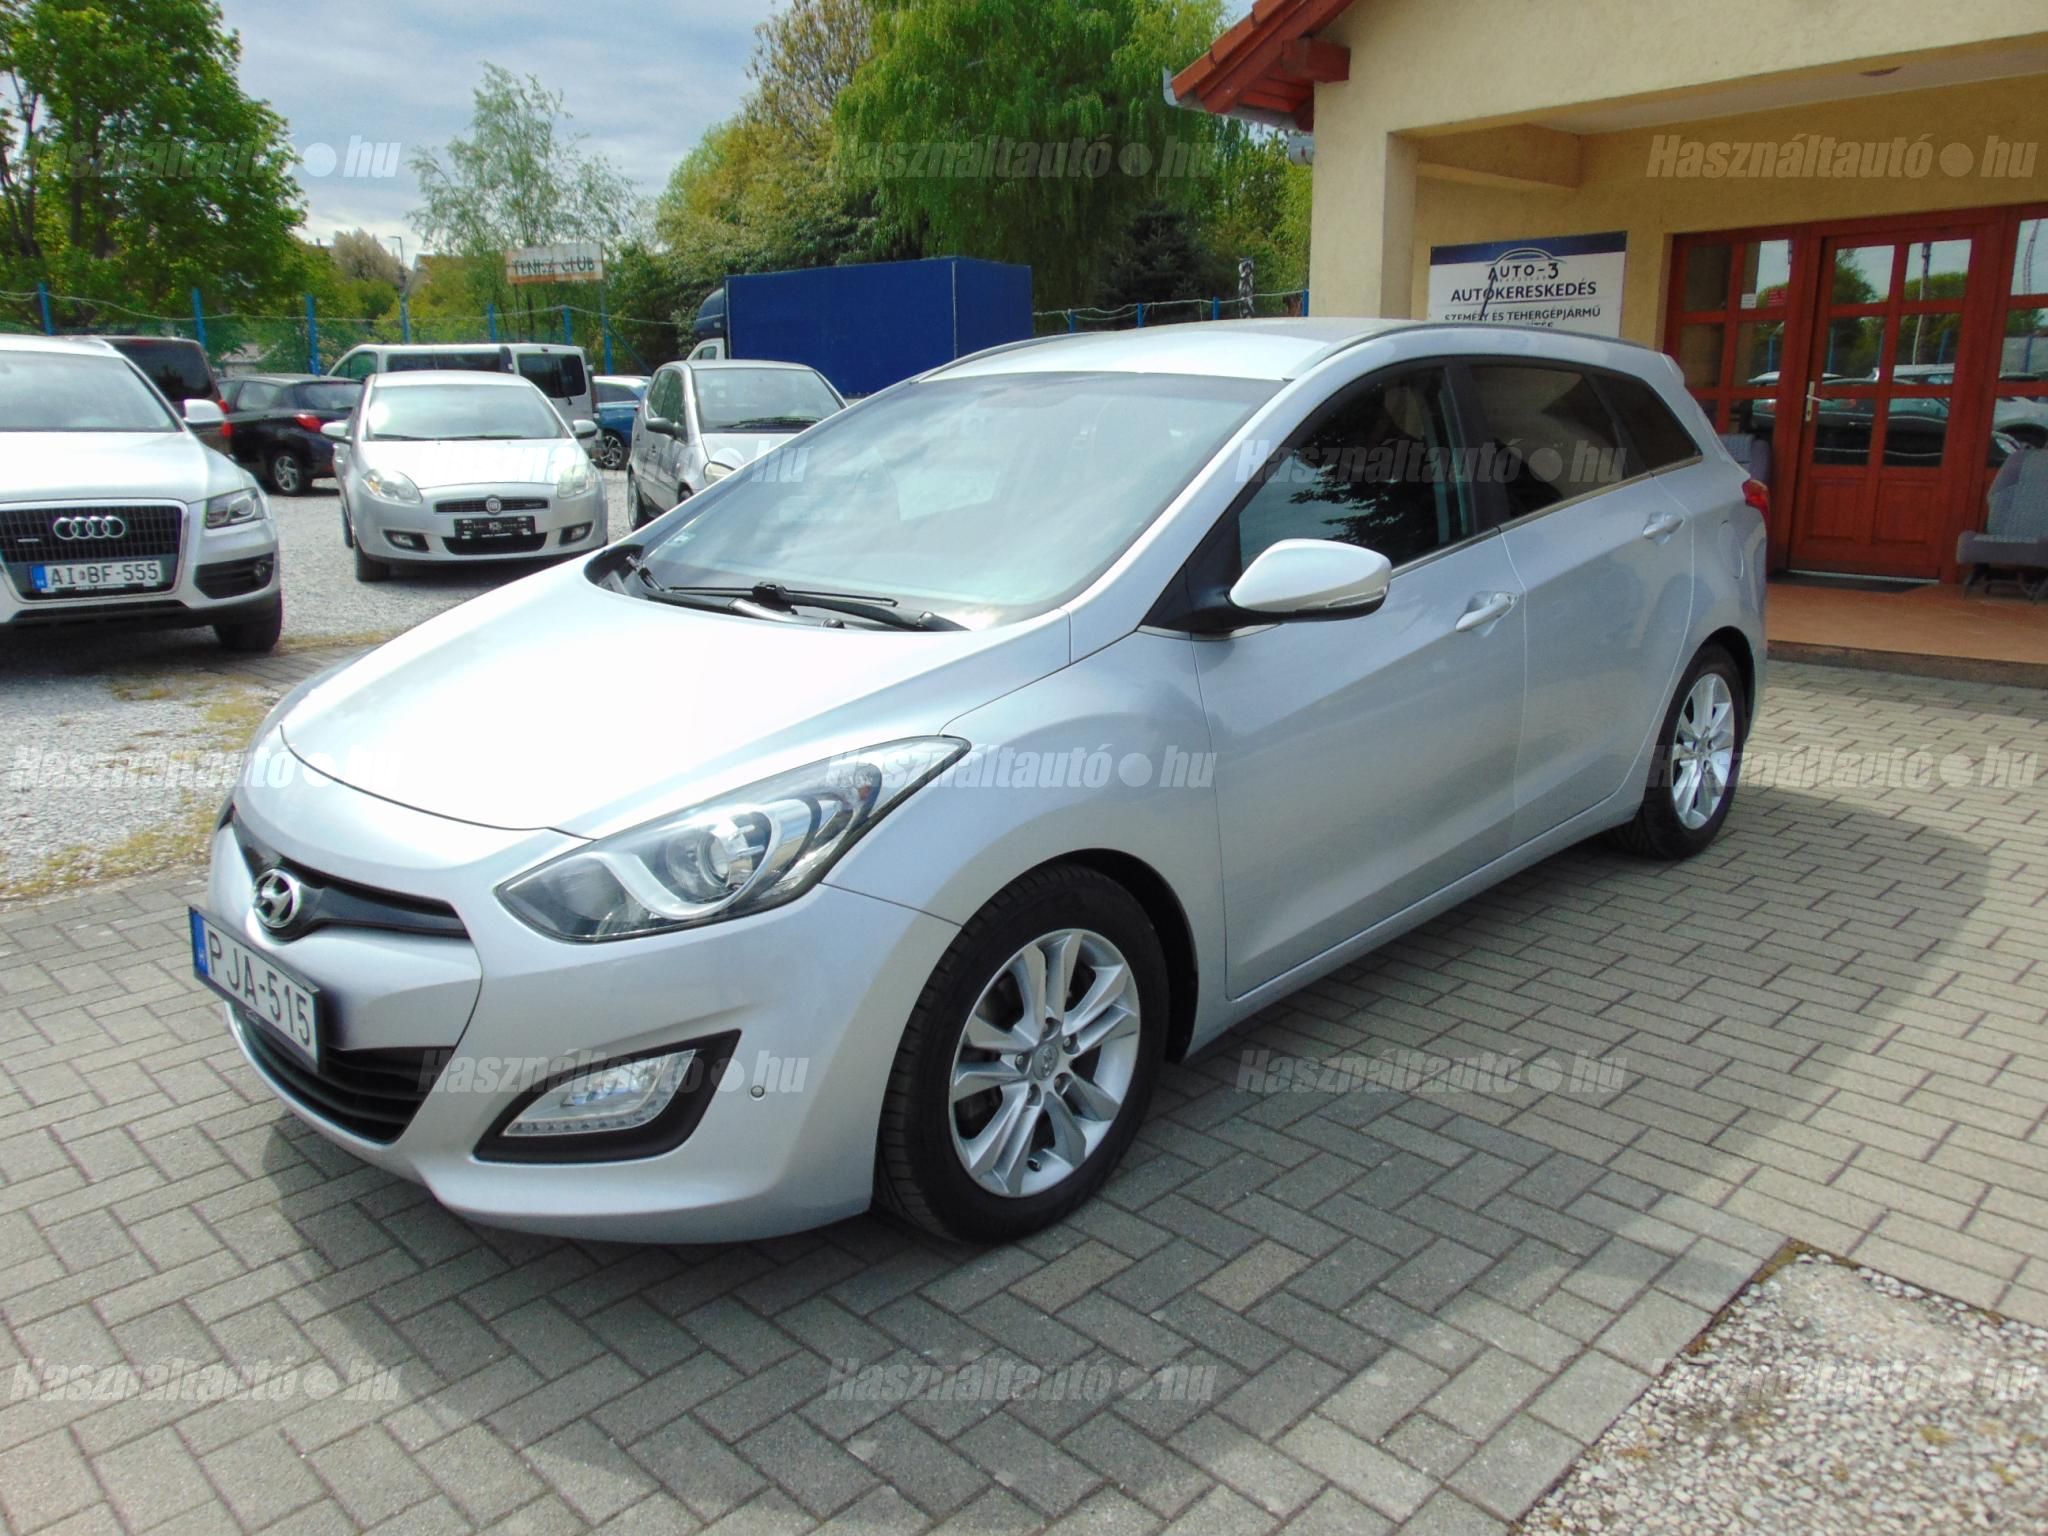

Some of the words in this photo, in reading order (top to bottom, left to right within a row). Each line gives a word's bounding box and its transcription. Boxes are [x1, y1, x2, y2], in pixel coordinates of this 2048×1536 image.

[561, 256, 595, 272] CLUB
[88, 563, 158, 584] BF-555
[208, 930, 311, 1047] PJA-515
